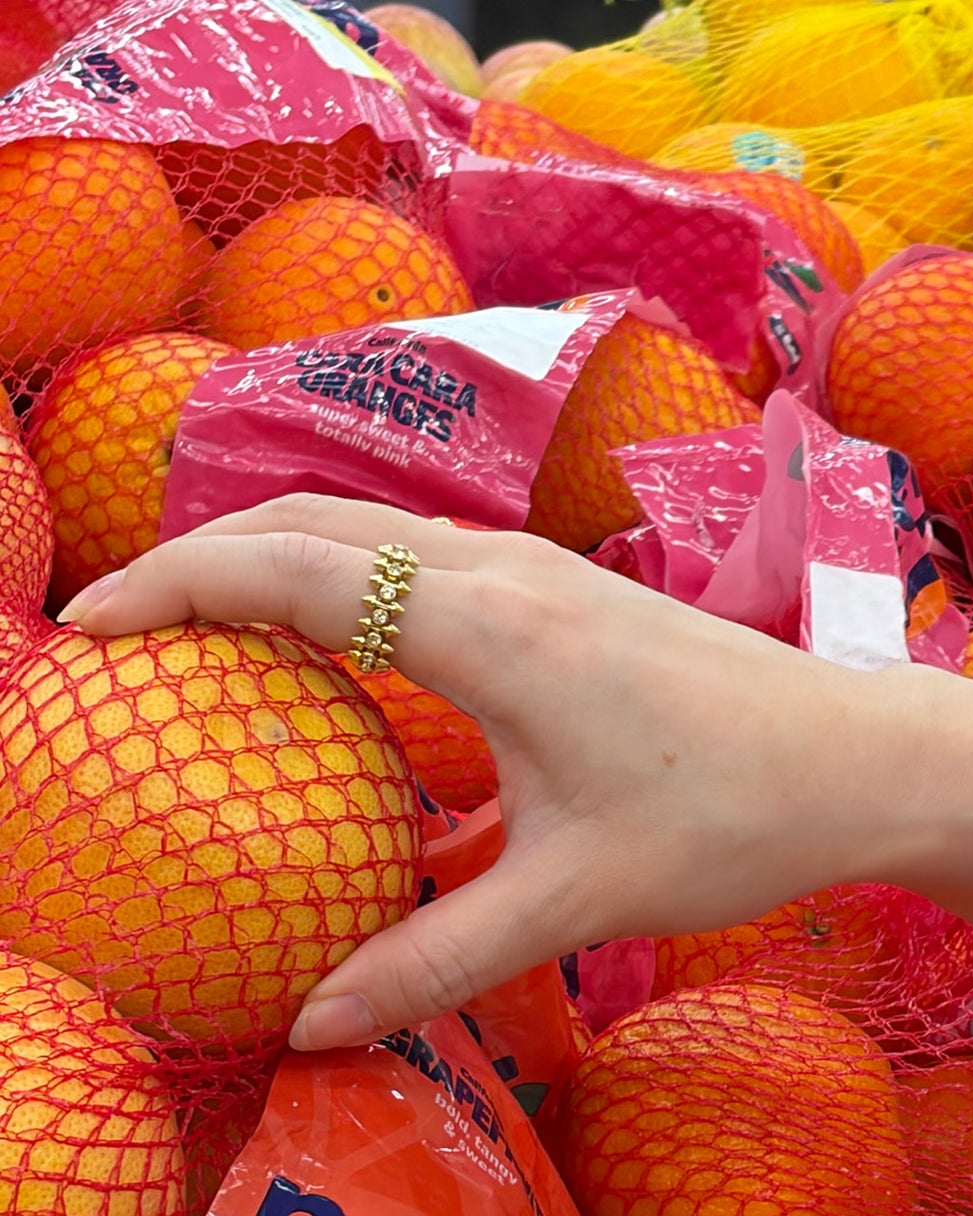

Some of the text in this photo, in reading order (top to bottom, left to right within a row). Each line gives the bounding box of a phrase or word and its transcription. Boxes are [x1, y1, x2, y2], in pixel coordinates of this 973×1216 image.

[368, 338, 427, 354] Califnia
[297, 369, 456, 443] ORANGES
[390, 353, 478, 418] CARA
[310, 404, 358, 430] super
[358, 420, 410, 451] sweet
[315, 420, 412, 469] totally pink
[434, 1092, 519, 1186] bold, tangy
[443, 1120, 506, 1187] & sweet
